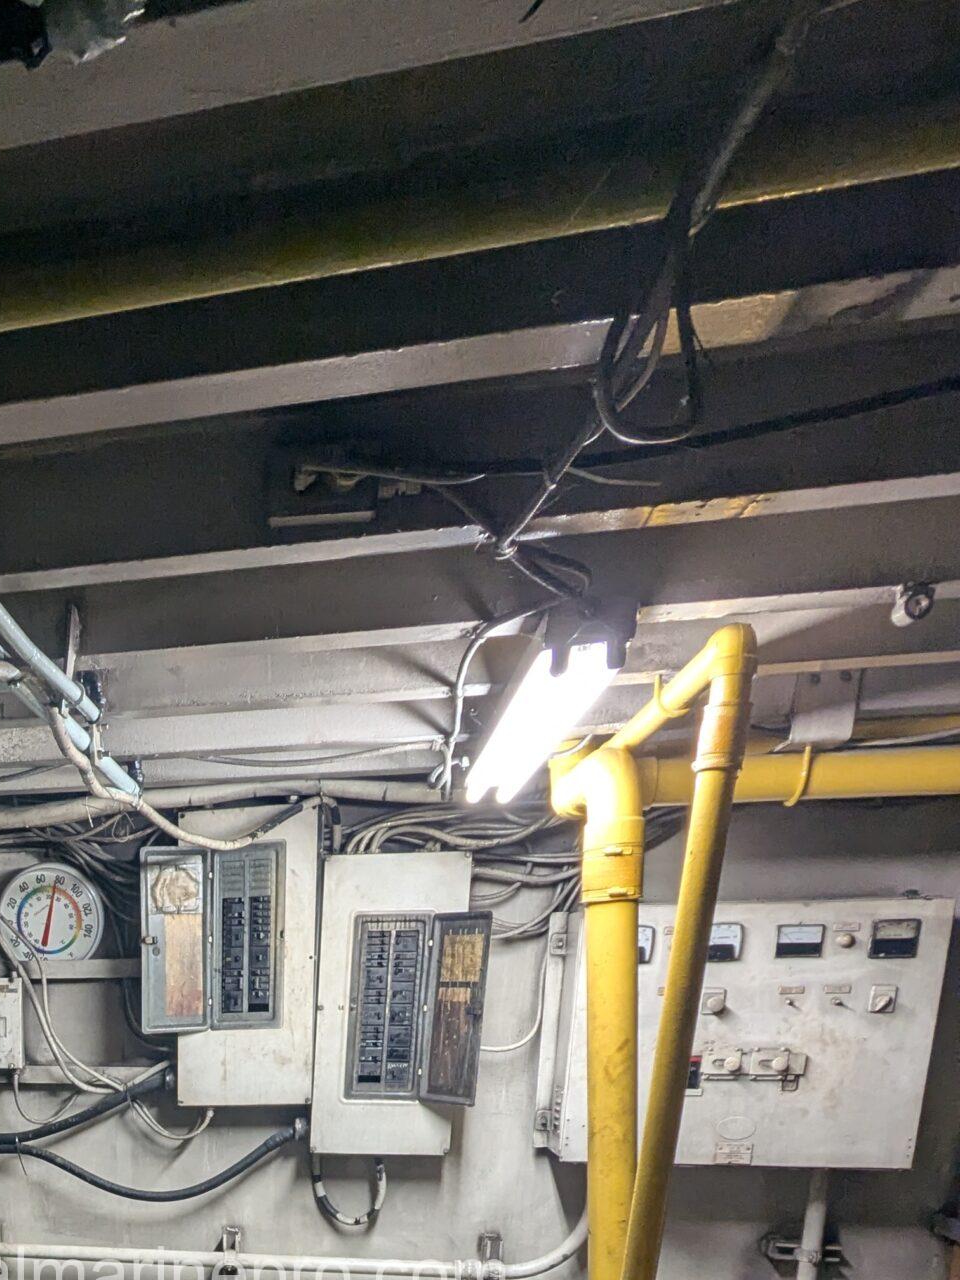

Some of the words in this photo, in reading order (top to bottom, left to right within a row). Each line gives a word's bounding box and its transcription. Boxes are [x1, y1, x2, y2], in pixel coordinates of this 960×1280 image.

[36, 874, 46, 884] 60
[55, 875, 66, 885] 80
[19, 882, 29, 893] 40
[71, 883, 83, 898] 100
[6, 897, 17, 910] 20
[82, 903, 93, 918] 120
[83, 924, 94, 938] 140
